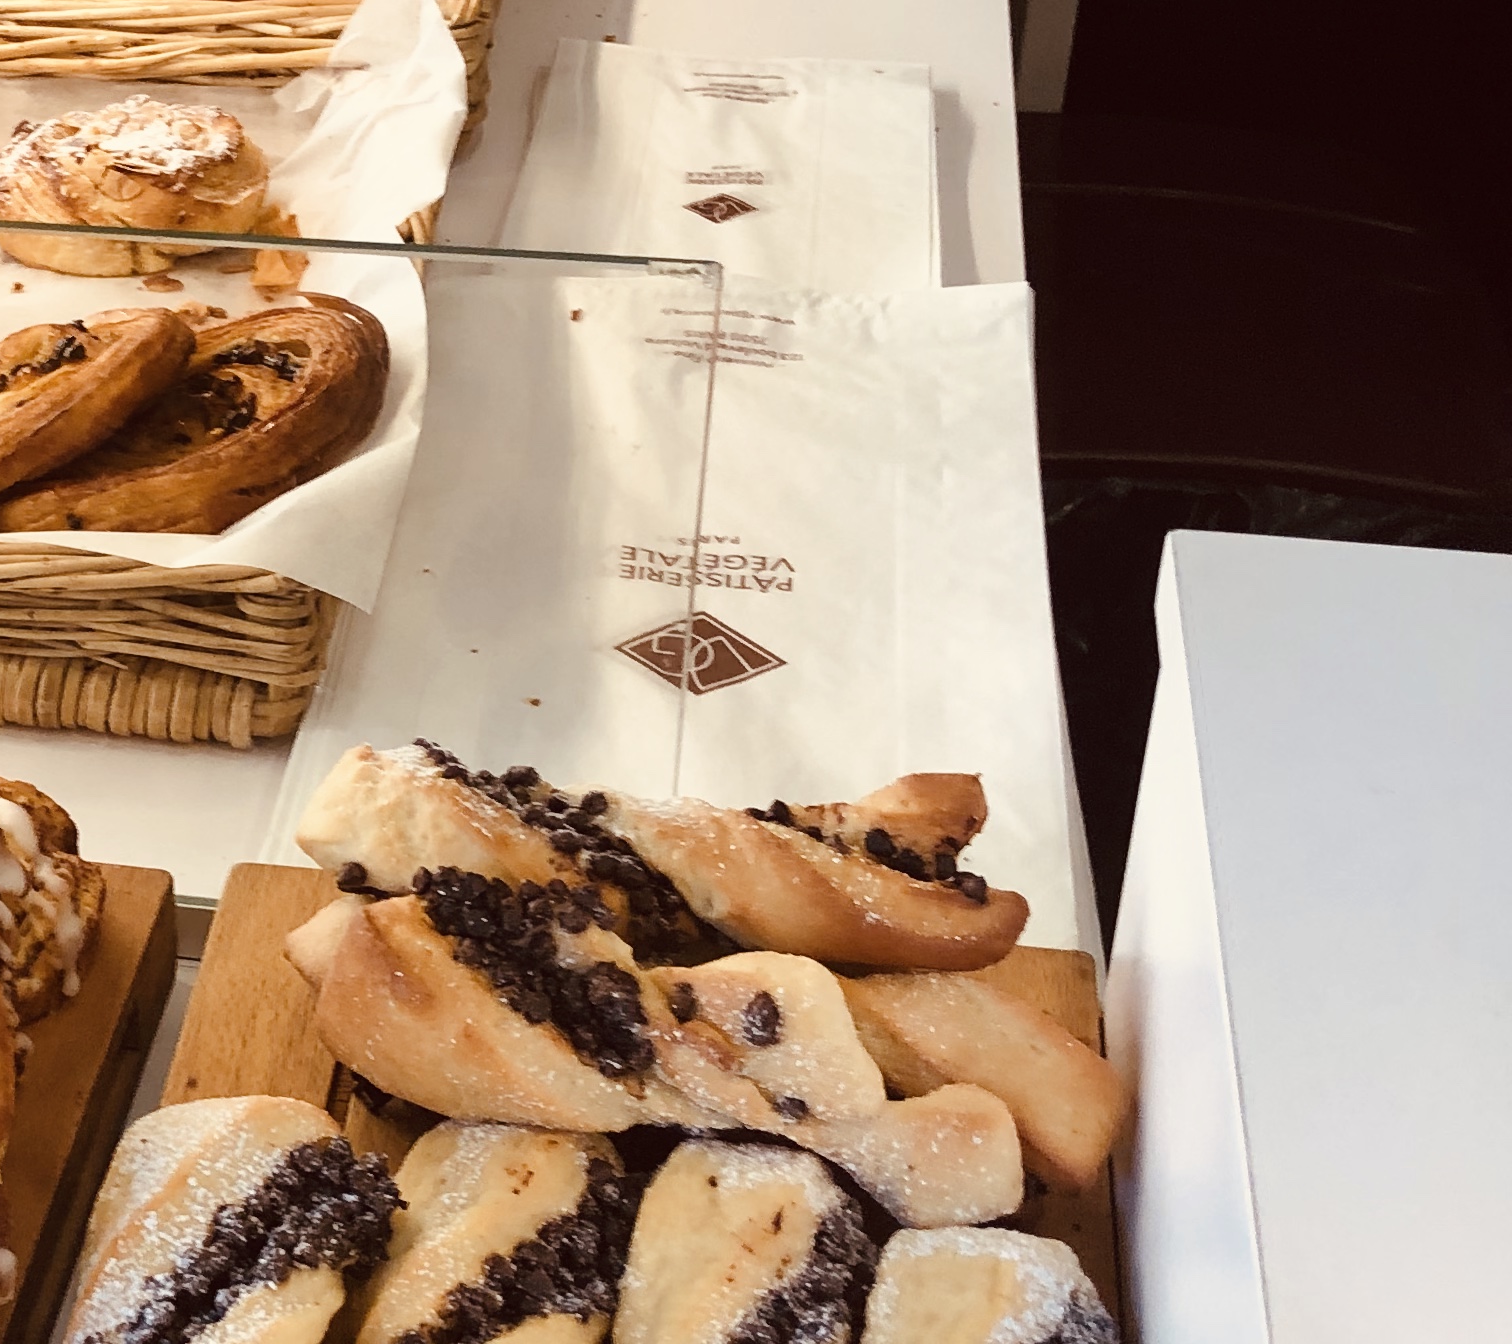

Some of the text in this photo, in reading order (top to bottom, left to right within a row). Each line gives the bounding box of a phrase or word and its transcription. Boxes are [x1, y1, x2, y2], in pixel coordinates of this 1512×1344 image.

[677, 535, 740, 545] PARS
[619, 545, 795, 572] VÉGÉTALE
[618, 563, 793, 593] PÂTISSERIE
